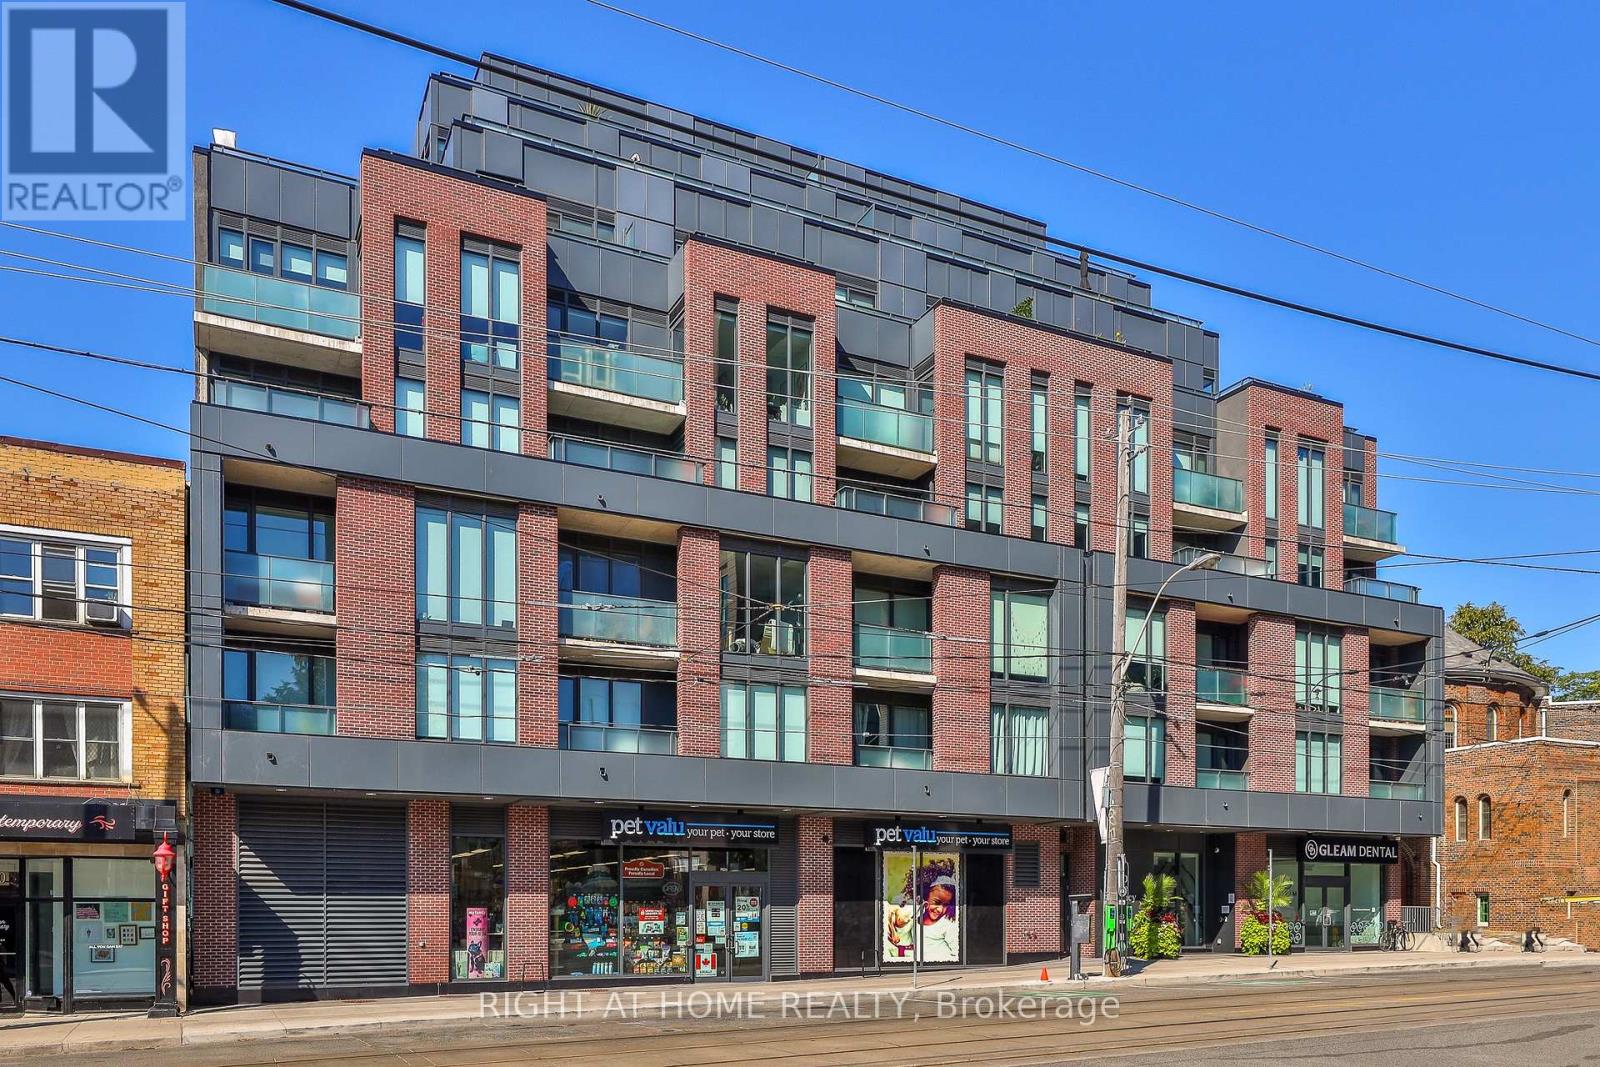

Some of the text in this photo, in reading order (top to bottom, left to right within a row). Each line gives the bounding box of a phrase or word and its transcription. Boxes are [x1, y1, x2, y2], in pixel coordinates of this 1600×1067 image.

[610, 816, 776, 840] pet valu your pet your store
[874, 825, 1010, 847] pet valu your pet your store
[1319, 844, 1398, 858] GLEAM DENTAL
